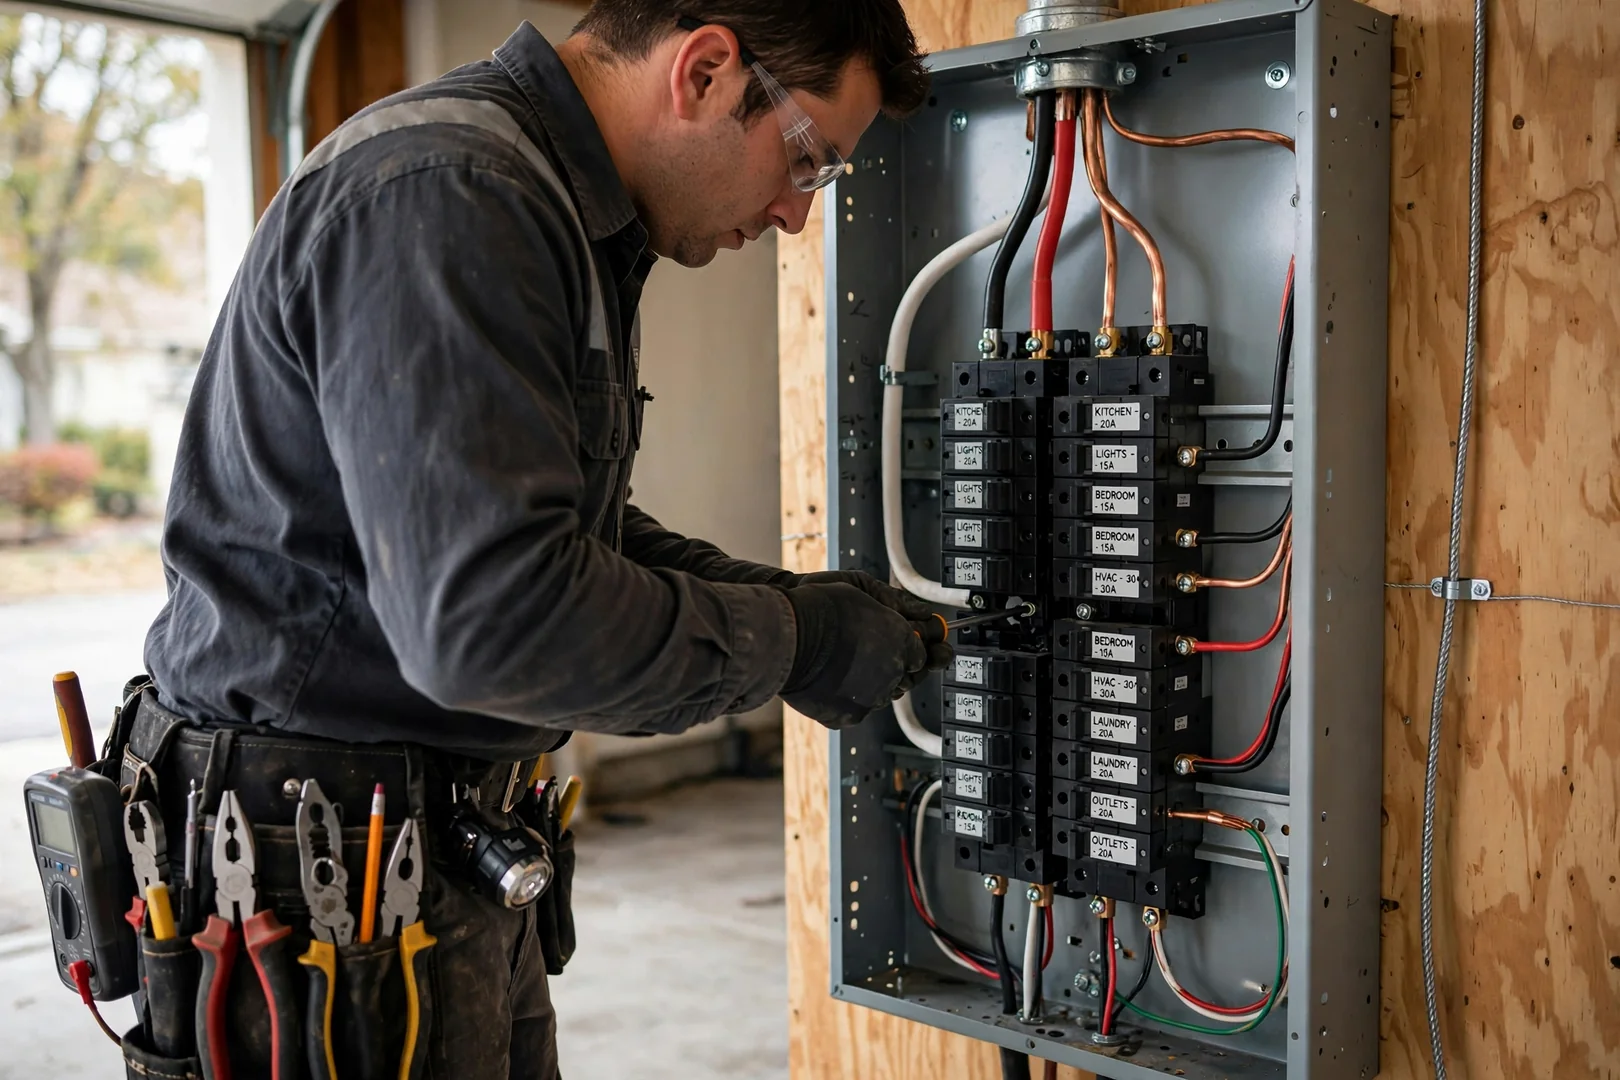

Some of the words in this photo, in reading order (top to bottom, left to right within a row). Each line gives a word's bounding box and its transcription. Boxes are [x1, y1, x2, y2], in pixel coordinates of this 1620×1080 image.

[1095, 407, 1132, 416] KITCHEN
[1101, 419, 1116, 428] 20A
[1096, 449, 1126, 458] LIGHTS
[1100, 461, 1114, 470] 15A
[1096, 490, 1135, 500] BEDROOM
[1101, 503, 1115, 511] 15A
[1096, 531, 1135, 541] BEDROOM
[1101, 543, 1115, 552] 15A
[1095, 572, 1117, 582] HVAC
[1101, 585, 1116, 593] 30A
[1099, 648, 1113, 658] 15A
[1094, 676, 1115, 687] HVAC
[1100, 689, 1115, 699] 30A
[1094, 716, 1131, 729] LAUNDRY
[1099, 728, 1113, 738] 20A
[1094, 756, 1131, 770] LAUNDRY
[1099, 769, 1114, 779] 20A
[1093, 796, 1128, 810] OUTLETS
[1099, 808, 1113, 818] 20A
[1092, 836, 1128, 850] OUTLETS
[1098, 848, 1113, 858] 20A
